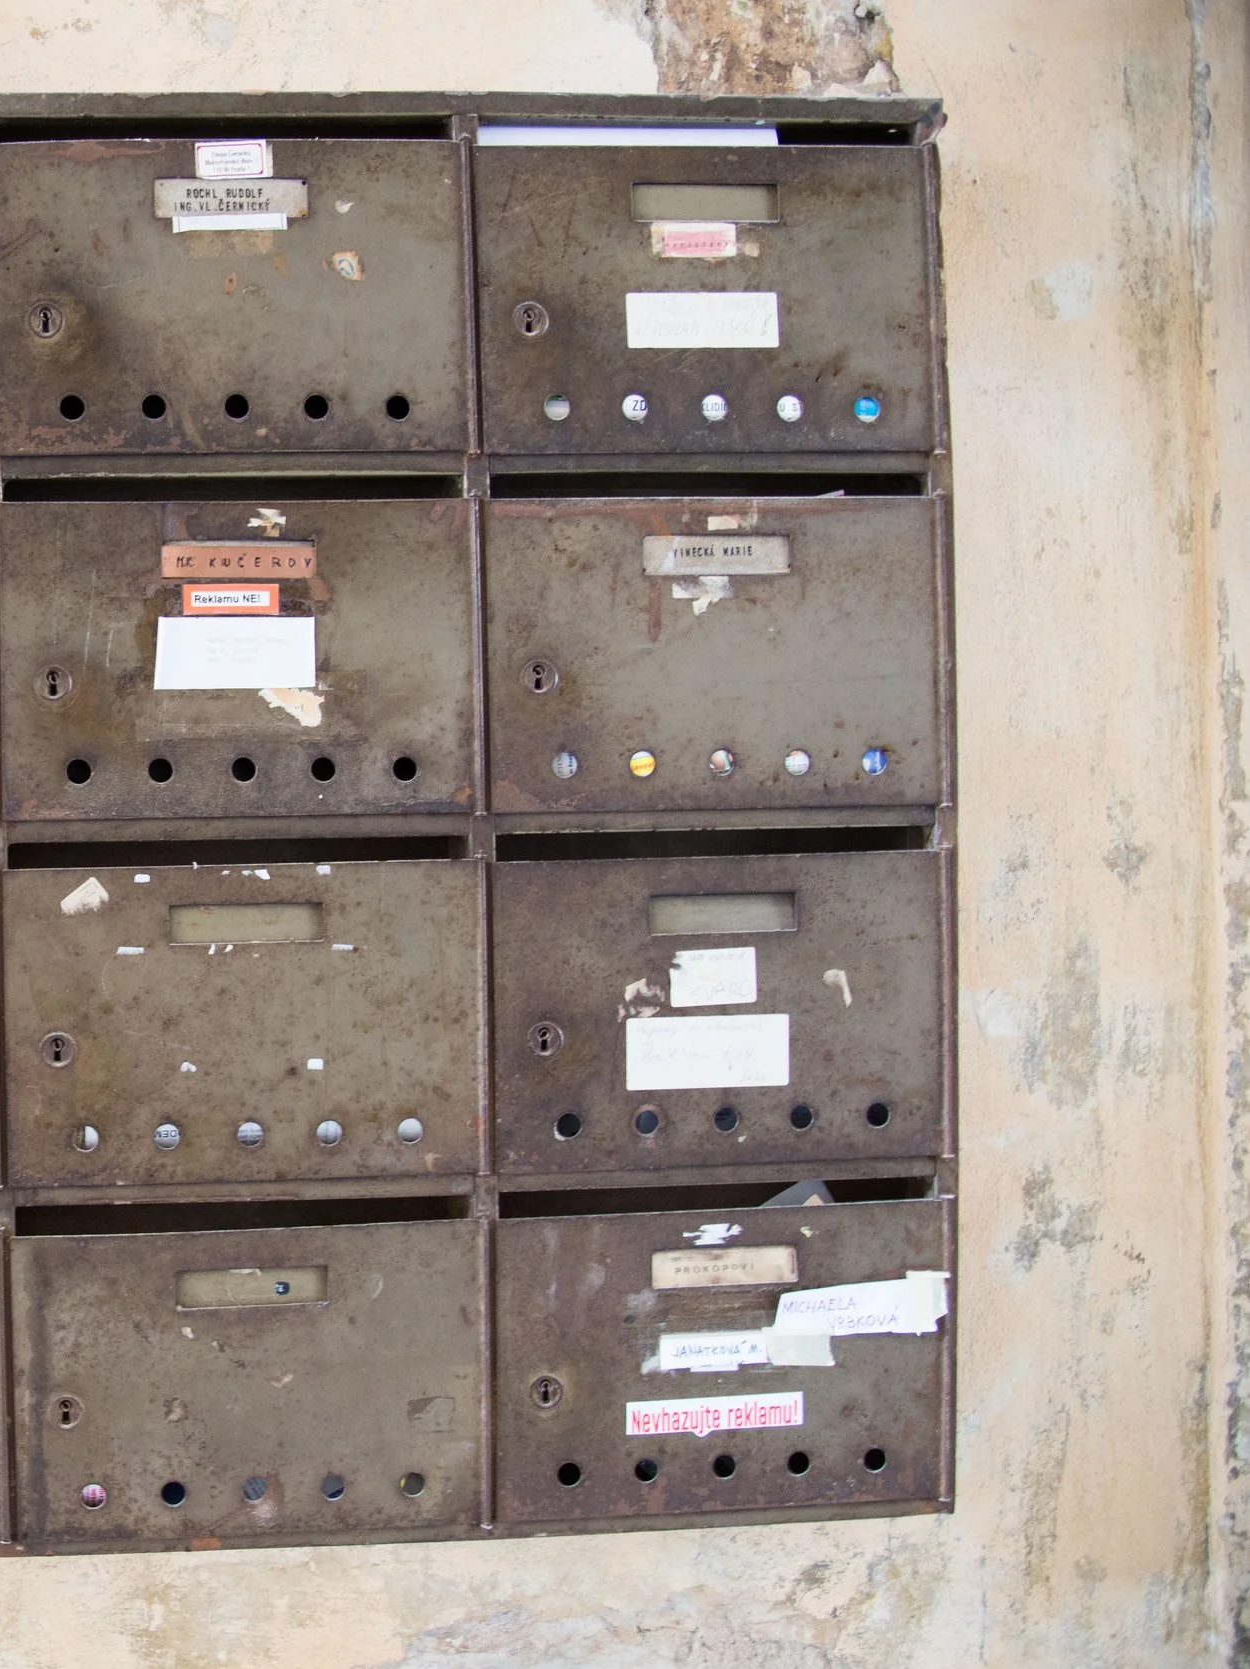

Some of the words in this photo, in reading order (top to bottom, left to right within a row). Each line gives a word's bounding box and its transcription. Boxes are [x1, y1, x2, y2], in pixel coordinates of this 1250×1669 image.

[186, 188, 218, 199] ROCHL
[226, 187, 263, 199] RUDOLF
[722, 546, 753, 557] MARIE
[193, 594, 240, 604] Reklamu
[242, 592, 261, 604] NE!
[674, 1263, 755, 1276] PROKOPOVI
[781, 1298, 858, 1314] MICHAELA
[826, 1304, 900, 1329] VRBKOVÁ
[631, 1400, 722, 1435] Nevhazujte
[727, 1399, 799, 1429] reklamu!
